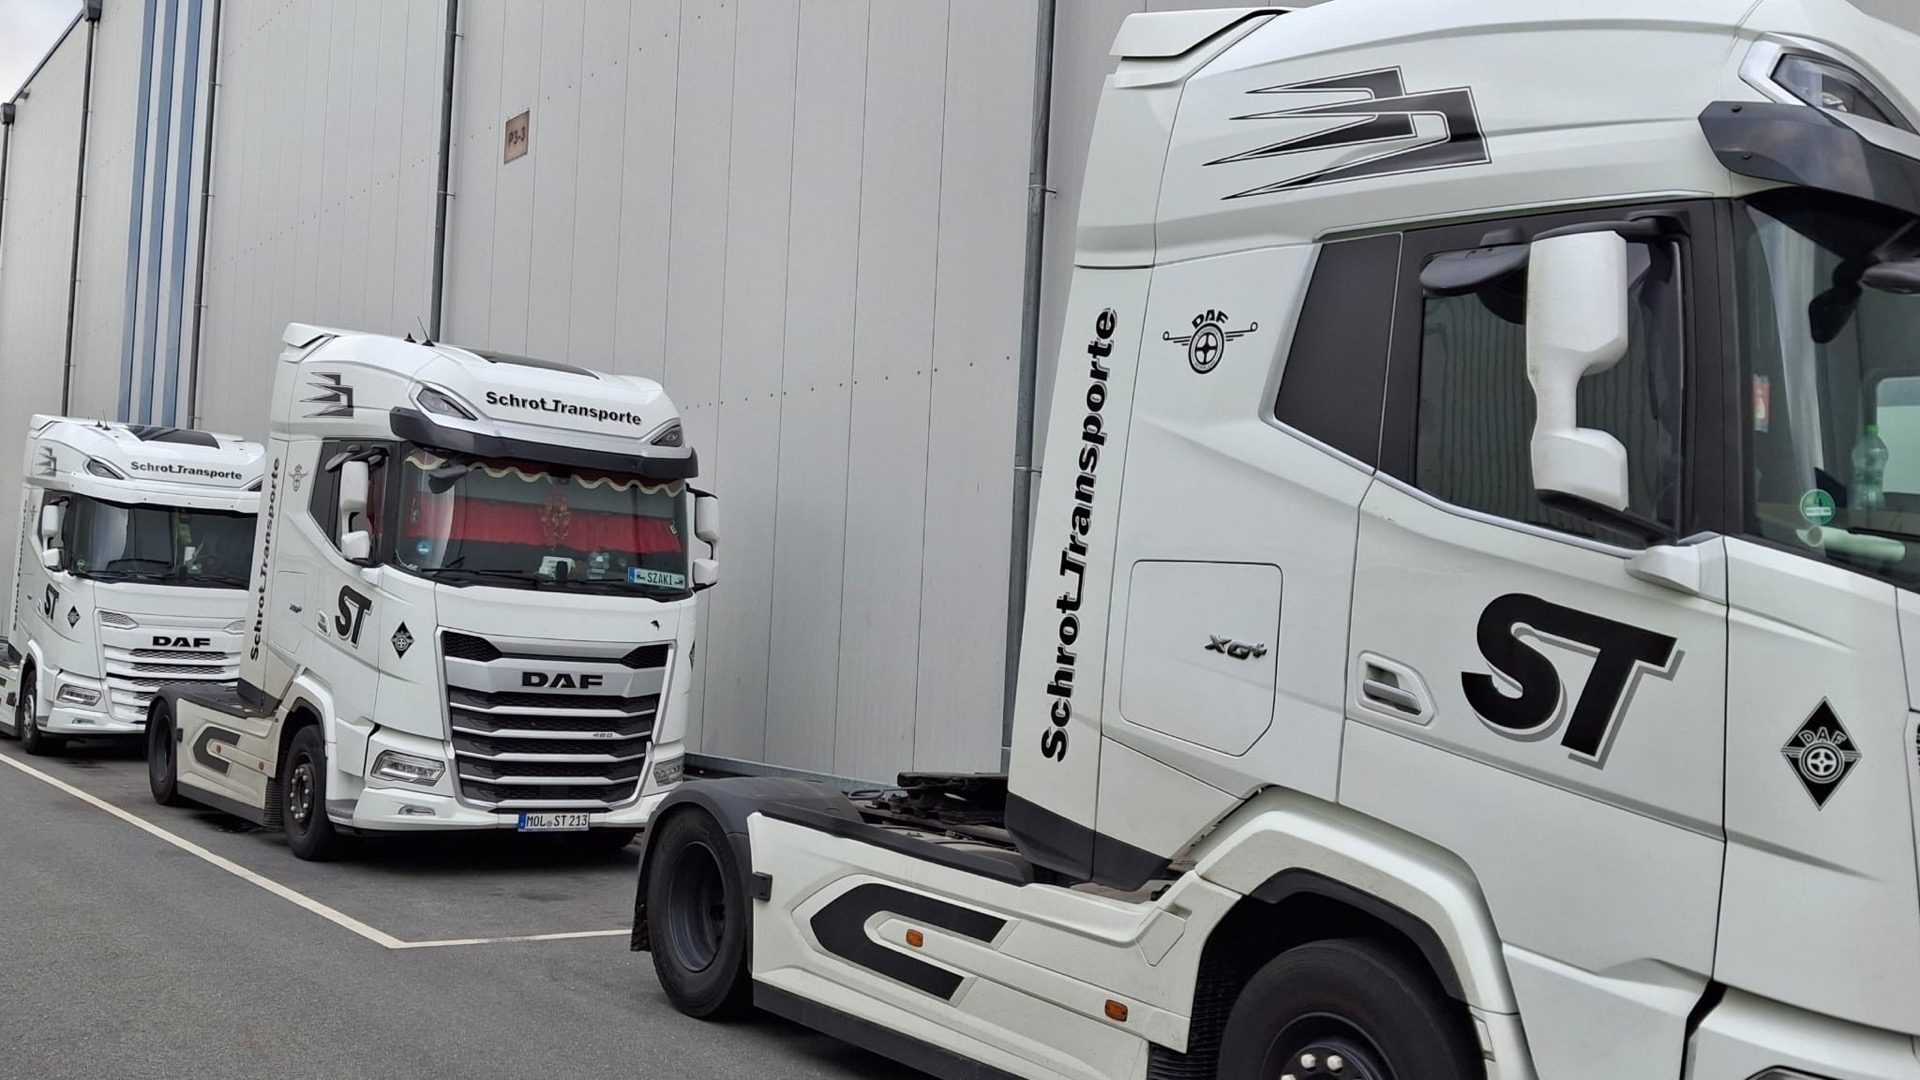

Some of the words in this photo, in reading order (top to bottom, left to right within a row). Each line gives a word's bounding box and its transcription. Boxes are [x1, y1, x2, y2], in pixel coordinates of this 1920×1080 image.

[508, 126, 526, 148] P3-3
[1191, 309, 1229, 329] DAF
[647, 571, 673, 586] SZAKI
[335, 585, 373, 649] ST
[152, 635, 211, 647] DAF
[522, 671, 604, 689] DAF
[1461, 593, 1686, 770] ST
[1798, 726, 1847, 748] DAF
[526, 815, 546, 827] MOL
[554, 815, 567, 827] ST
[569, 814, 588, 827] 213
